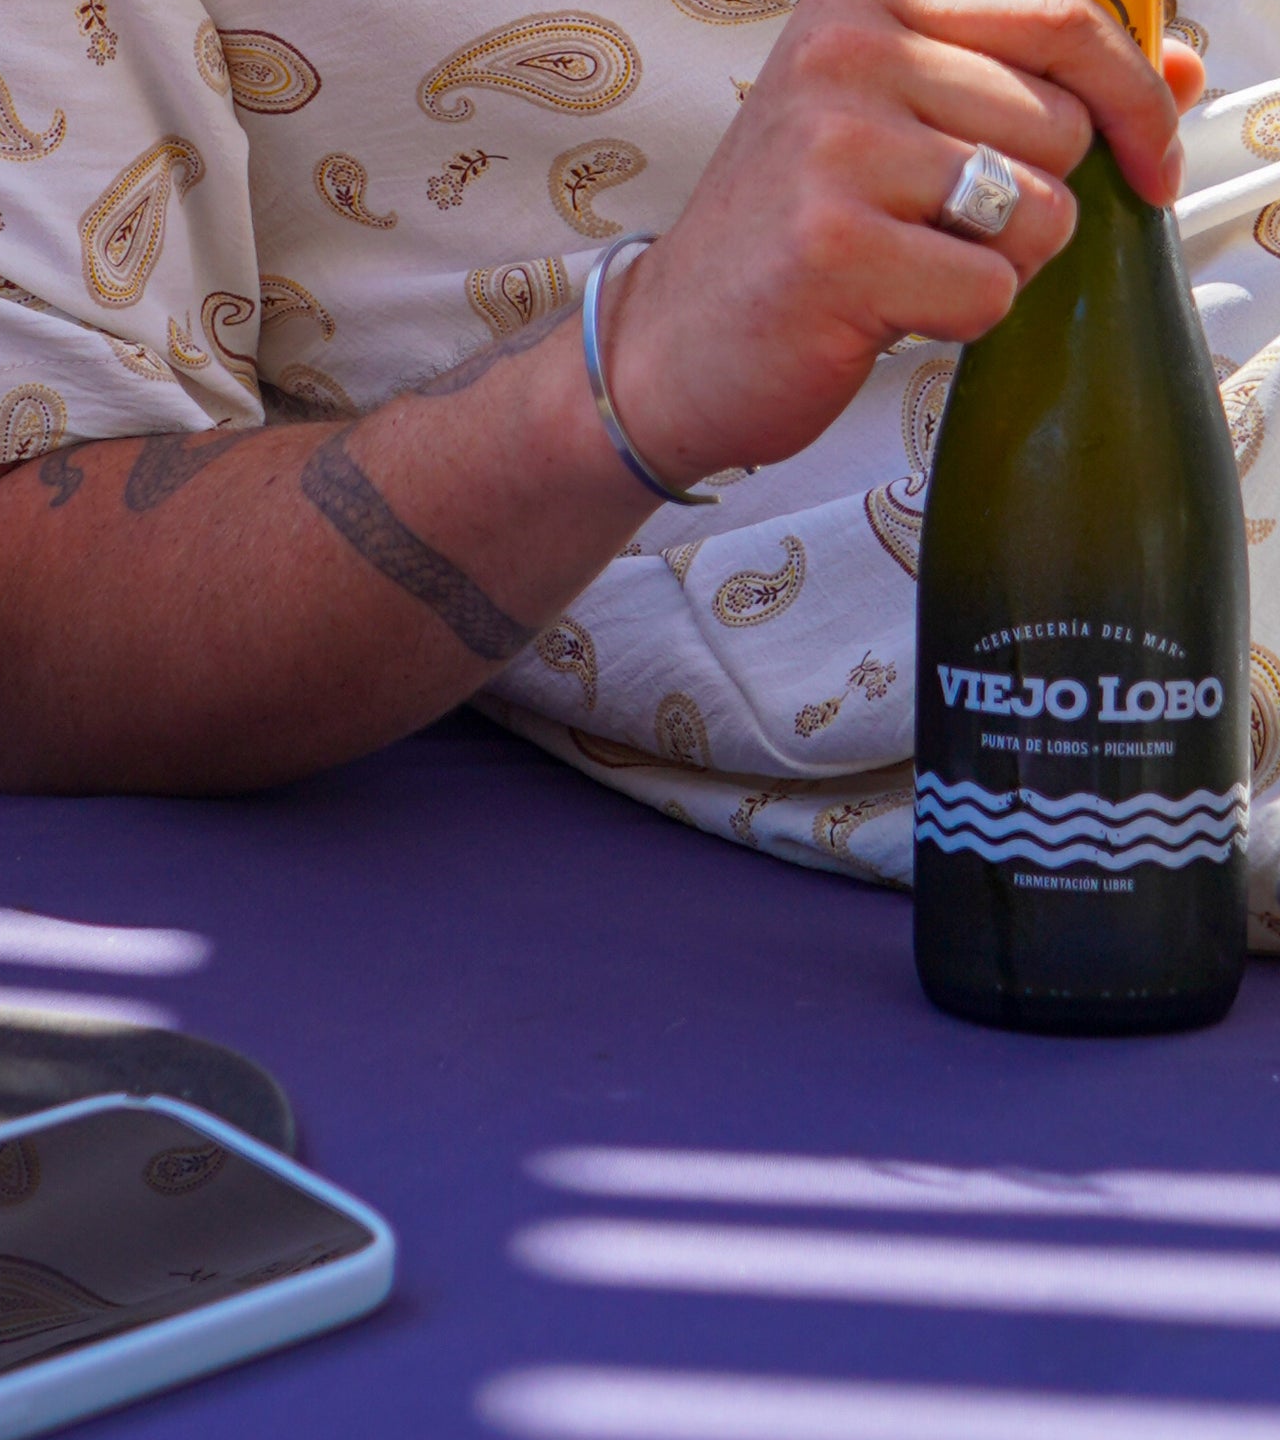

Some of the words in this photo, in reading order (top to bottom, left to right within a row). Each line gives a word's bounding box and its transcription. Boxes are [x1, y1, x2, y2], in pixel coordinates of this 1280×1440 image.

[980, 618, 1090, 652] CERVECERÍA
[1101, 623, 1133, 643] DEL
[1142, 631, 1180, 658] MAR
[936, 664, 1089, 721] VIEJO
[1097, 676, 1224, 724] LOBO
[980, 732, 1020, 751] PUNTA
[1025, 738, 1042, 753] DE
[1046, 739, 1089, 755] LOBOS
[1104, 740, 1175, 757] PICHILEMU
[1013, 872, 1099, 891] FERMENTACIÓN
[1103, 878, 1135, 892] LIBRE
